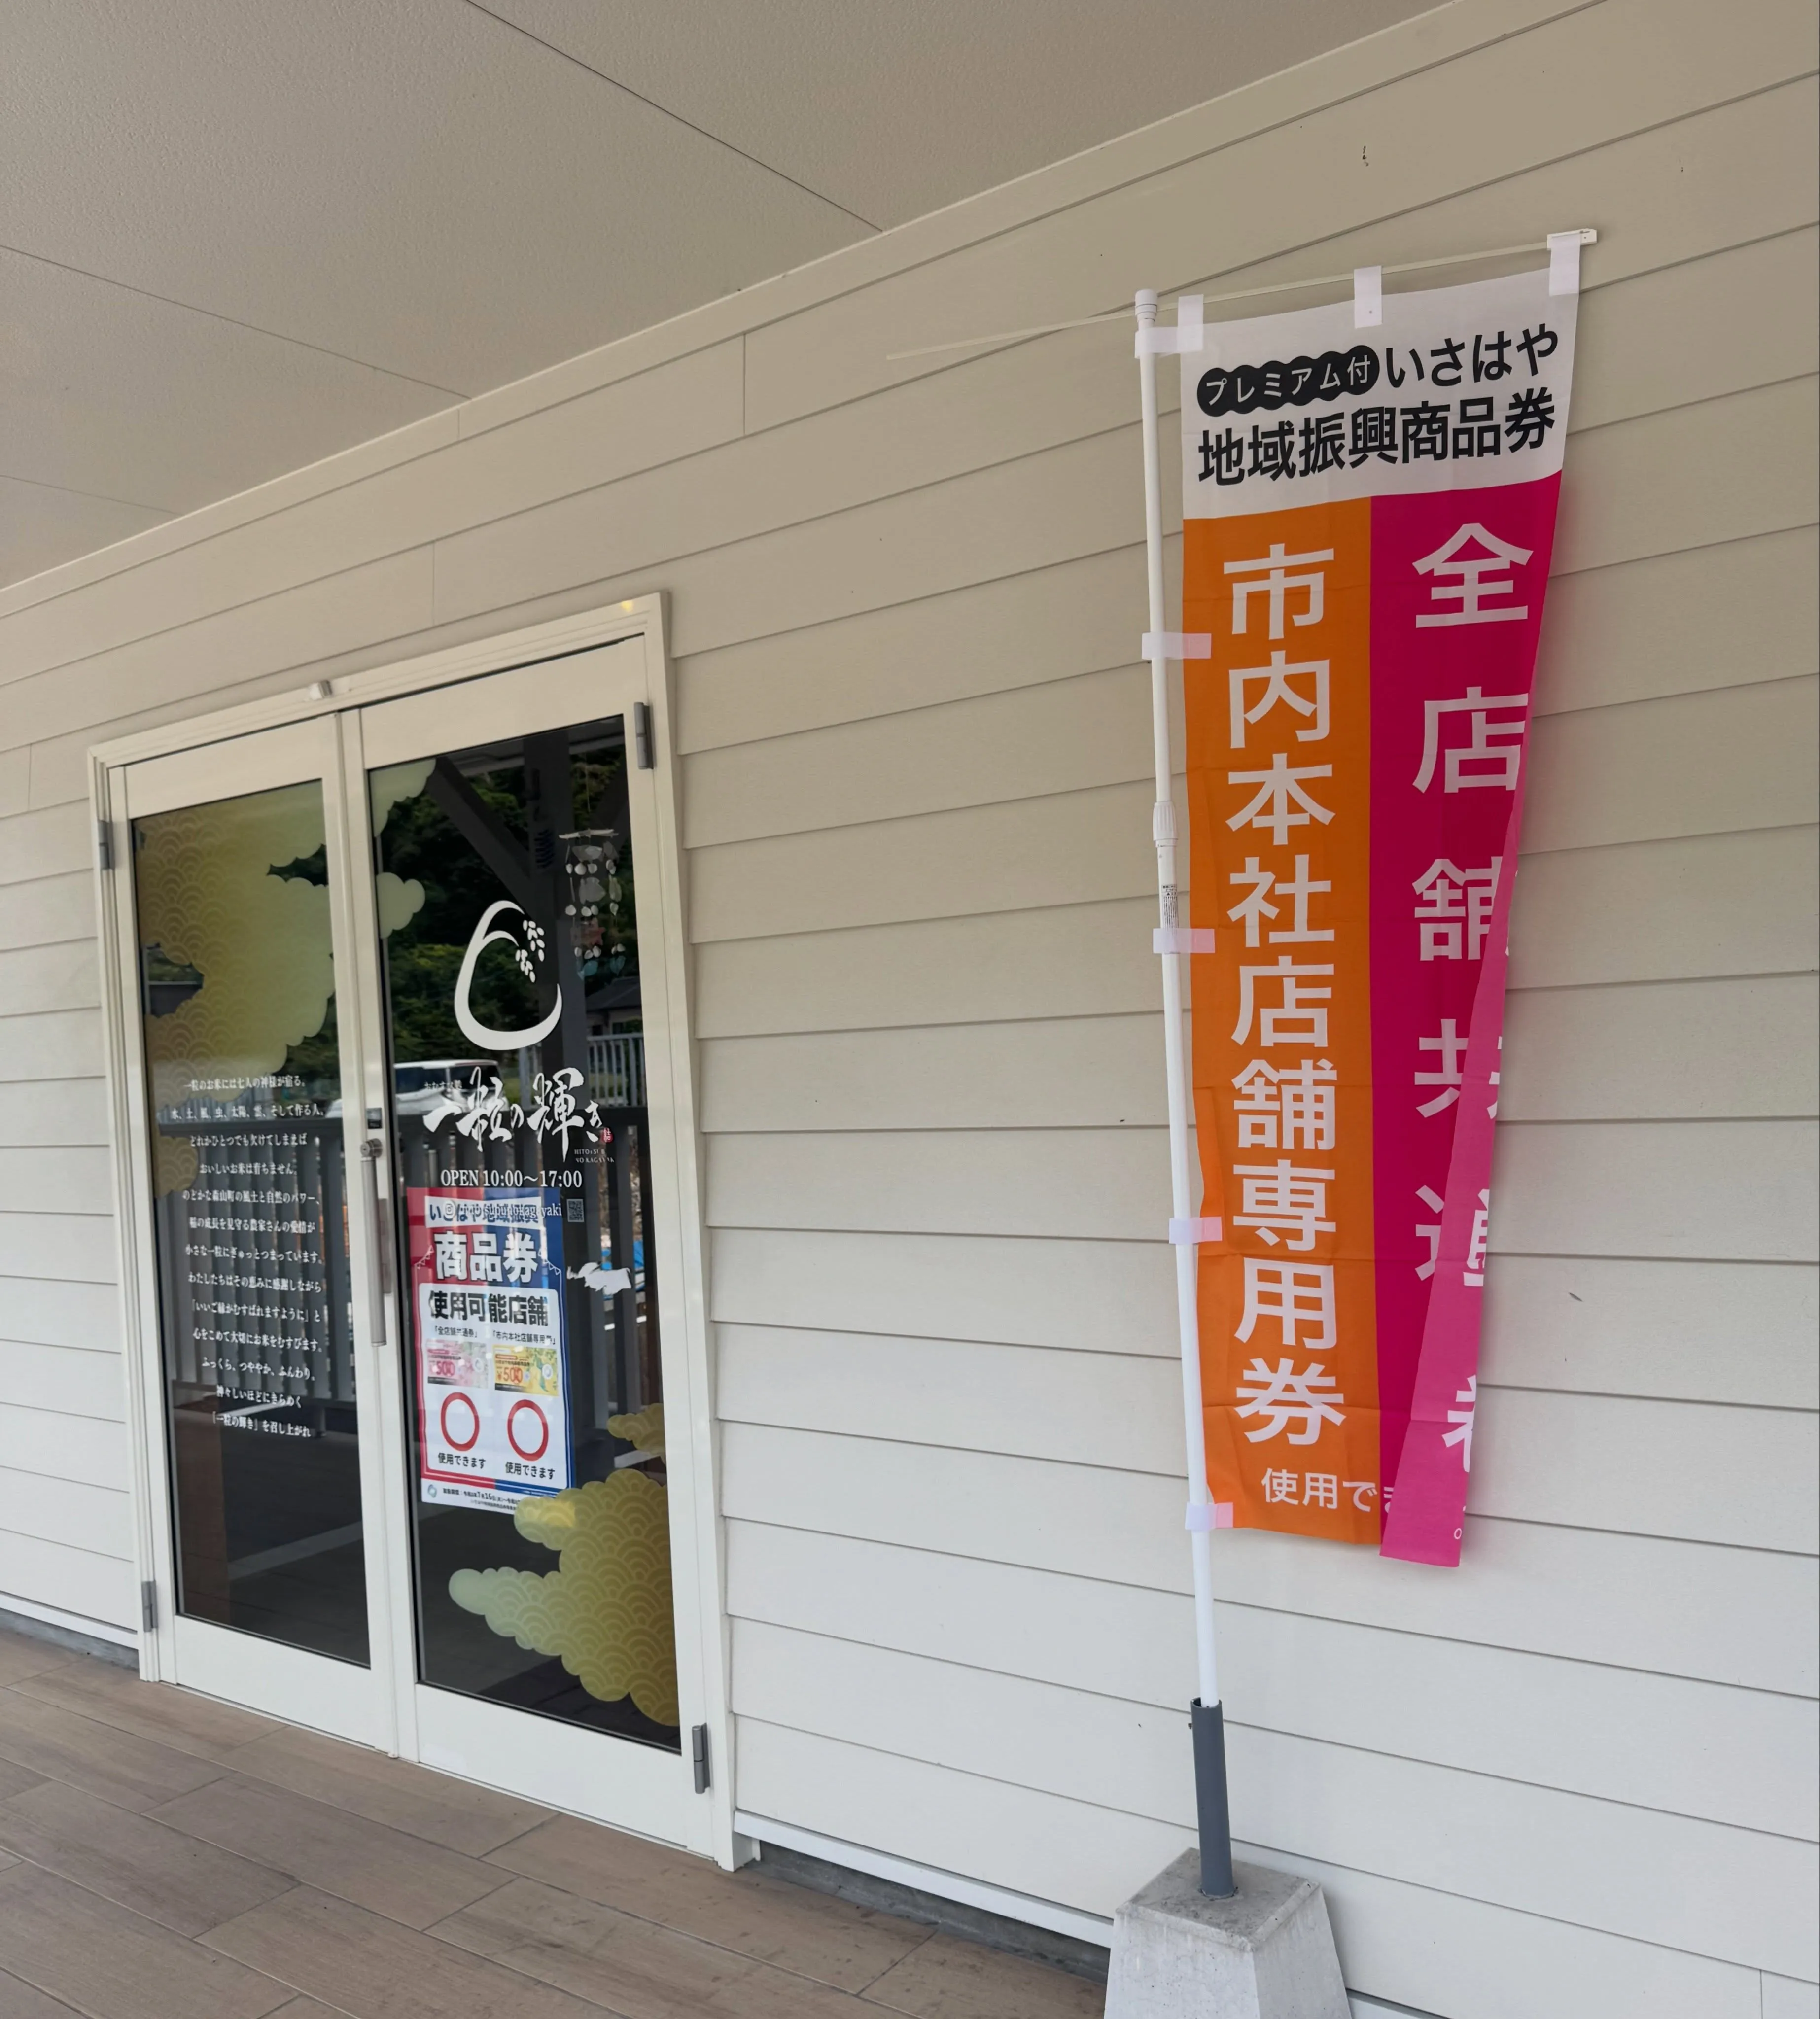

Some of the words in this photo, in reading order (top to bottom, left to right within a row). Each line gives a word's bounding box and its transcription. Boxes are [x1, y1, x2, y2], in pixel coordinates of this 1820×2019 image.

[1206, 354, 1371, 406] プレミアム付
[1385, 322, 1558, 388] いさはや
[1198, 387, 1555, 485] 地域振興商品券
[1224, 543, 1346, 1445] 市内本社店舗専用券
[440, 1170, 480, 1187] OPEN
[434, 1231, 538, 1283] 商品券
[429, 1290, 549, 1327] 使用可能店舗
[437, 1452, 486, 1469] 使用できます
[505, 1462, 556, 1480] 使用できます
